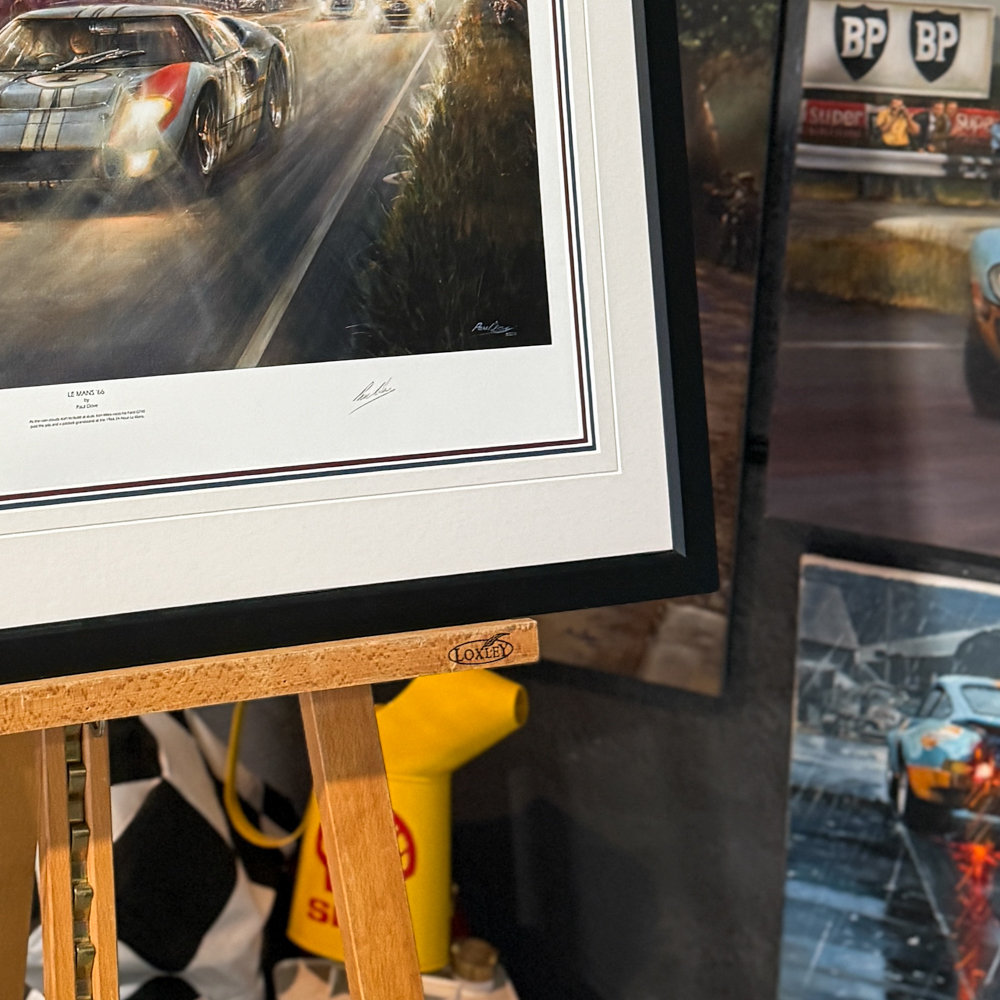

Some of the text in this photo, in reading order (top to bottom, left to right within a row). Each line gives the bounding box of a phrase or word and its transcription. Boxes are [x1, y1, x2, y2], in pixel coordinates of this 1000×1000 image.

[841, 16, 887, 59] BP
[915, 20, 959, 62] BP
[454, 642, 509, 663] LOXLEY
